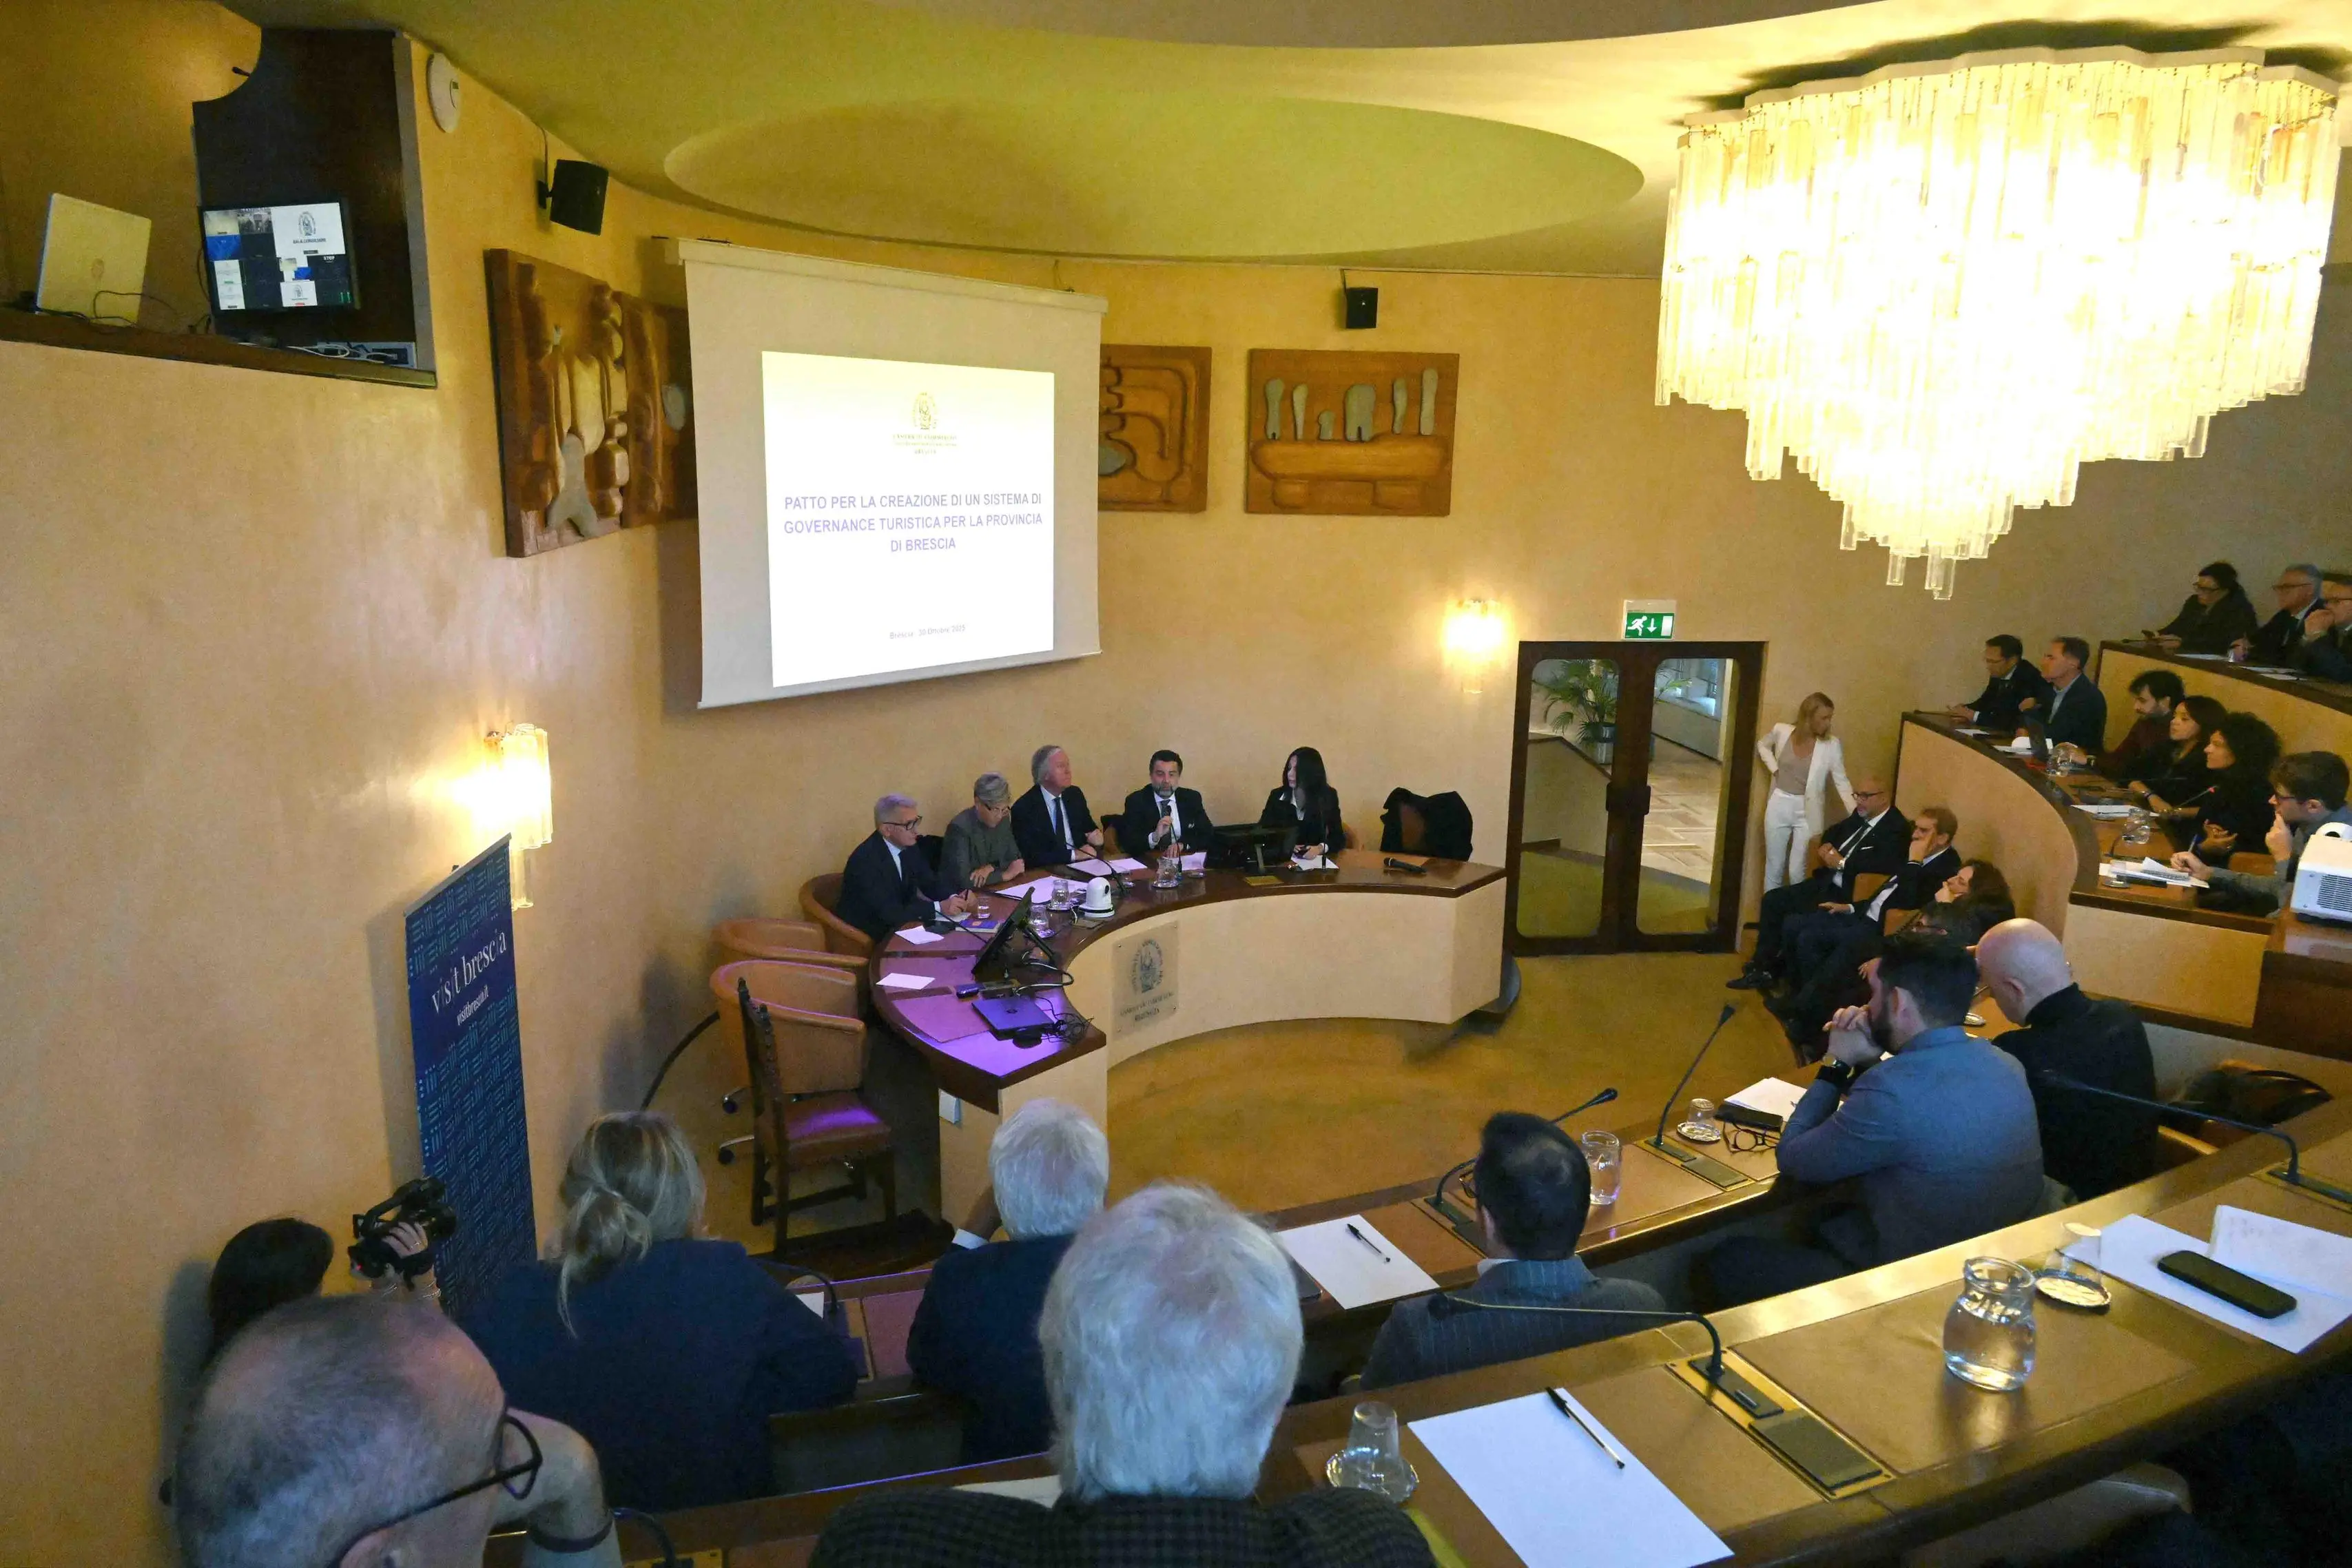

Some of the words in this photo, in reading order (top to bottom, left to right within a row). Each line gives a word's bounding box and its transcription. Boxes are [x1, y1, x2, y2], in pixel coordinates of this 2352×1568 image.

[785, 496, 827, 510] PATTO
[831, 495, 856, 508] PER
[860, 495, 876, 508] LA
[880, 494, 948, 508] CREAZIONE
[951, 493, 962, 506] DI
[965, 493, 980, 506] UN
[984, 493, 1029, 506] SISTEMA
[1031, 493, 1042, 504] DI
[784, 518, 876, 534] GOVERNANCE
[879, 516, 942, 530] TURISTICA
[944, 515, 966, 528] PER
[969, 515, 984, 527] LA
[987, 513, 1043, 526] PROVINCIA
[891, 539, 902, 552] DI
[906, 537, 956, 551] BRESCIA
[431, 967, 461, 1015] visit
[461, 928, 506, 987] brescia
[456, 984, 489, 1026] visitbrescia.it
